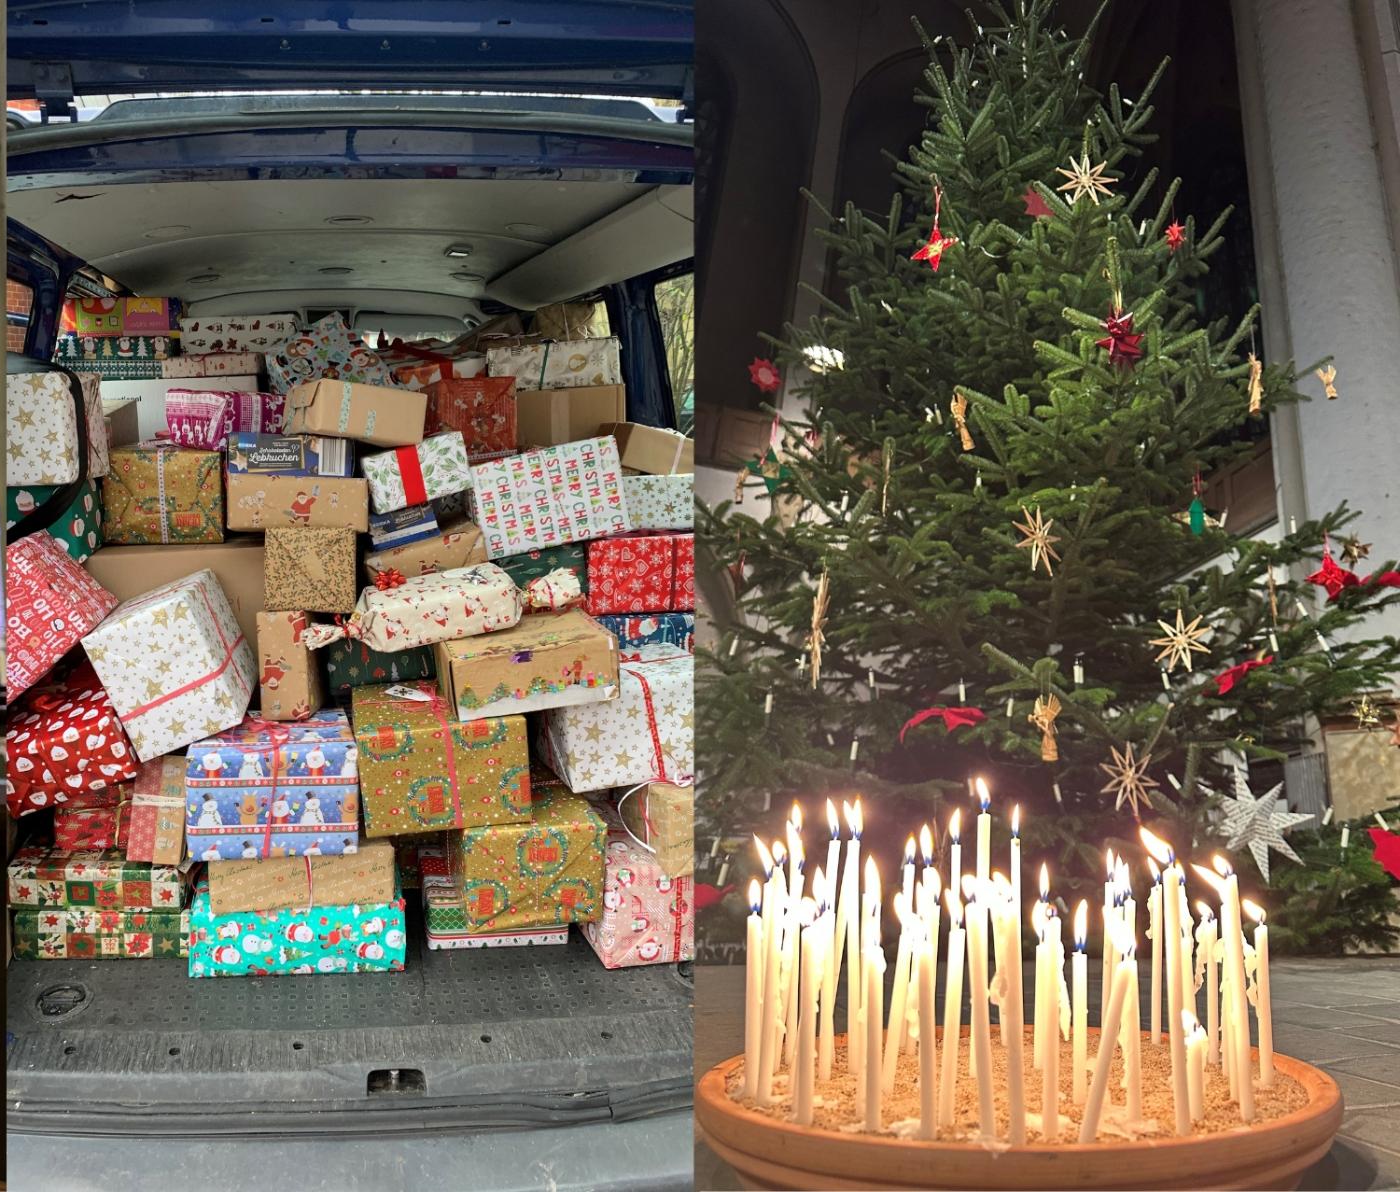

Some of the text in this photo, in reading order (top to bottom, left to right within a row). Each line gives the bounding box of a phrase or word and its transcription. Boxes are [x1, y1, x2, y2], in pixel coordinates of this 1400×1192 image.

[248, 451, 300, 464] Lebkuchen
[565, 459, 584, 498] MERRY
[580, 443, 604, 514] CHRISTMAS
[603, 472, 622, 511] MERRY
[480, 491, 500, 529] MERRY
[519, 504, 538, 543] MERRY
[8, 616, 32, 640] HO
[33, 599, 55, 621] HO
